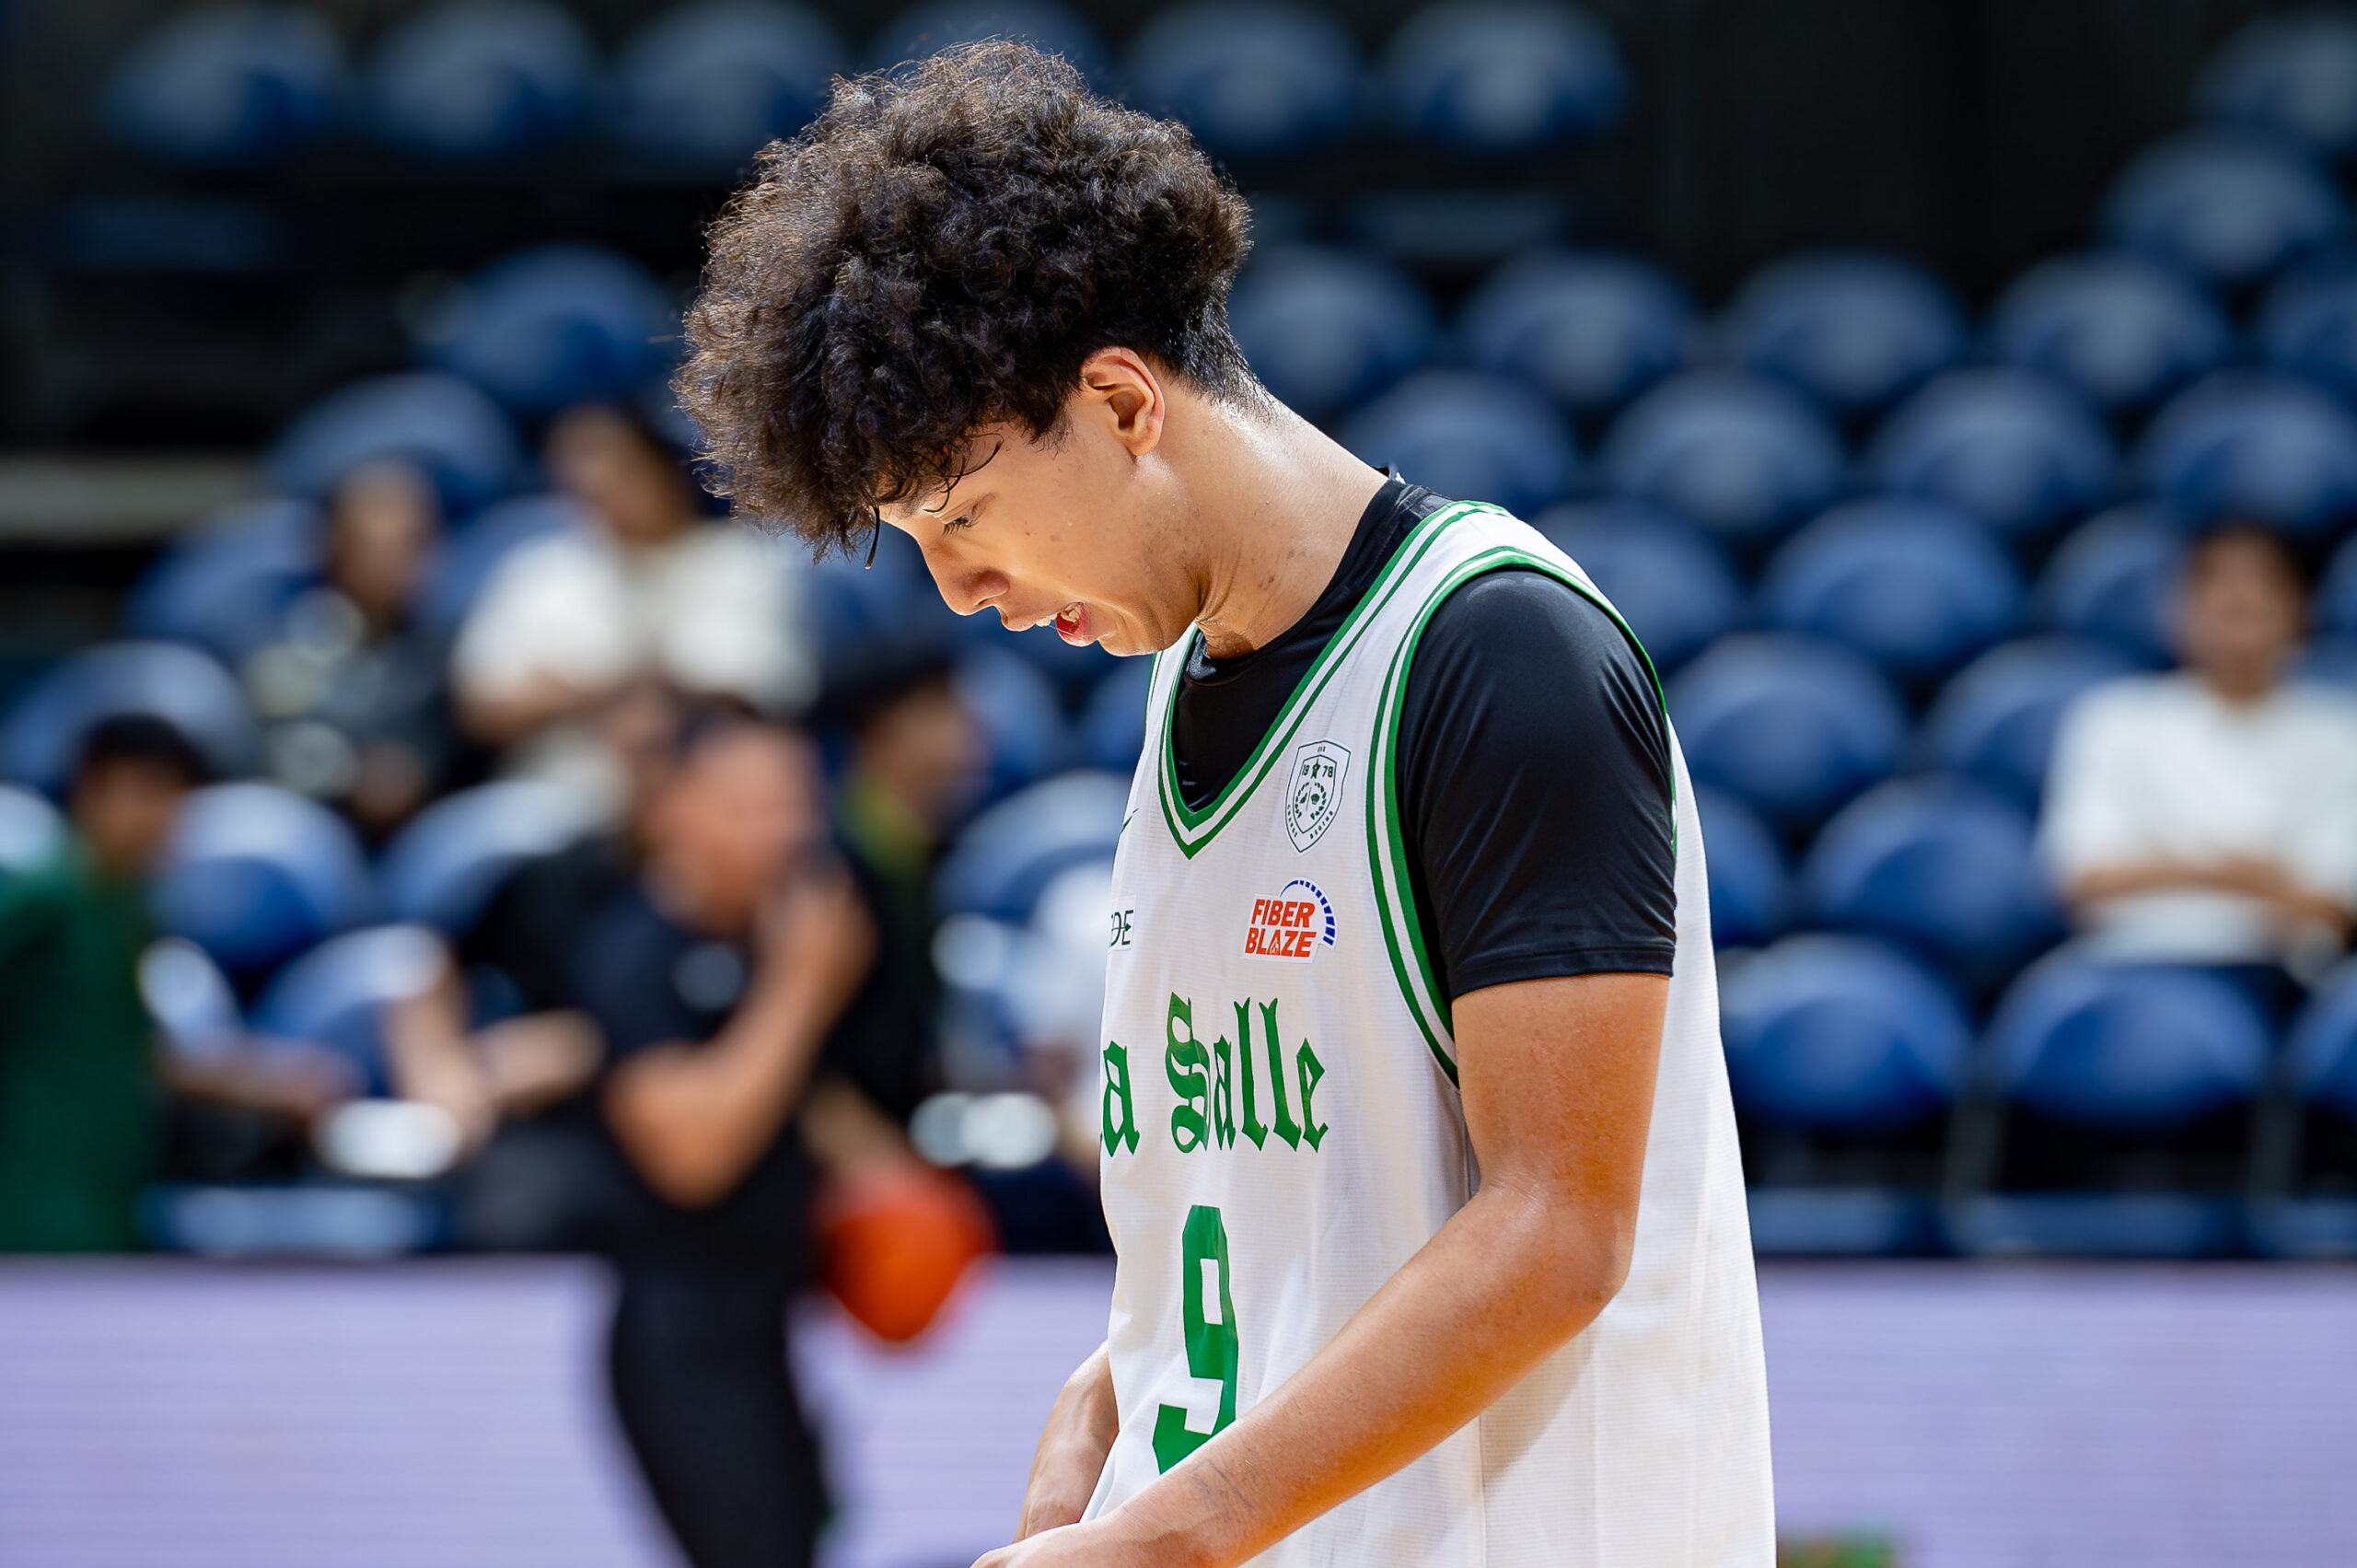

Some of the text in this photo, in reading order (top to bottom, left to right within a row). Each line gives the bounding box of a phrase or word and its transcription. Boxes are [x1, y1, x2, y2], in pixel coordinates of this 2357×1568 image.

[1322, 765, 1334, 778] 78
[1250, 899, 1316, 928] FIBER
[1245, 927, 1317, 958] BLAZE
[1100, 991, 1329, 1157] a Salle
[1152, 1204, 1239, 1476] 9
